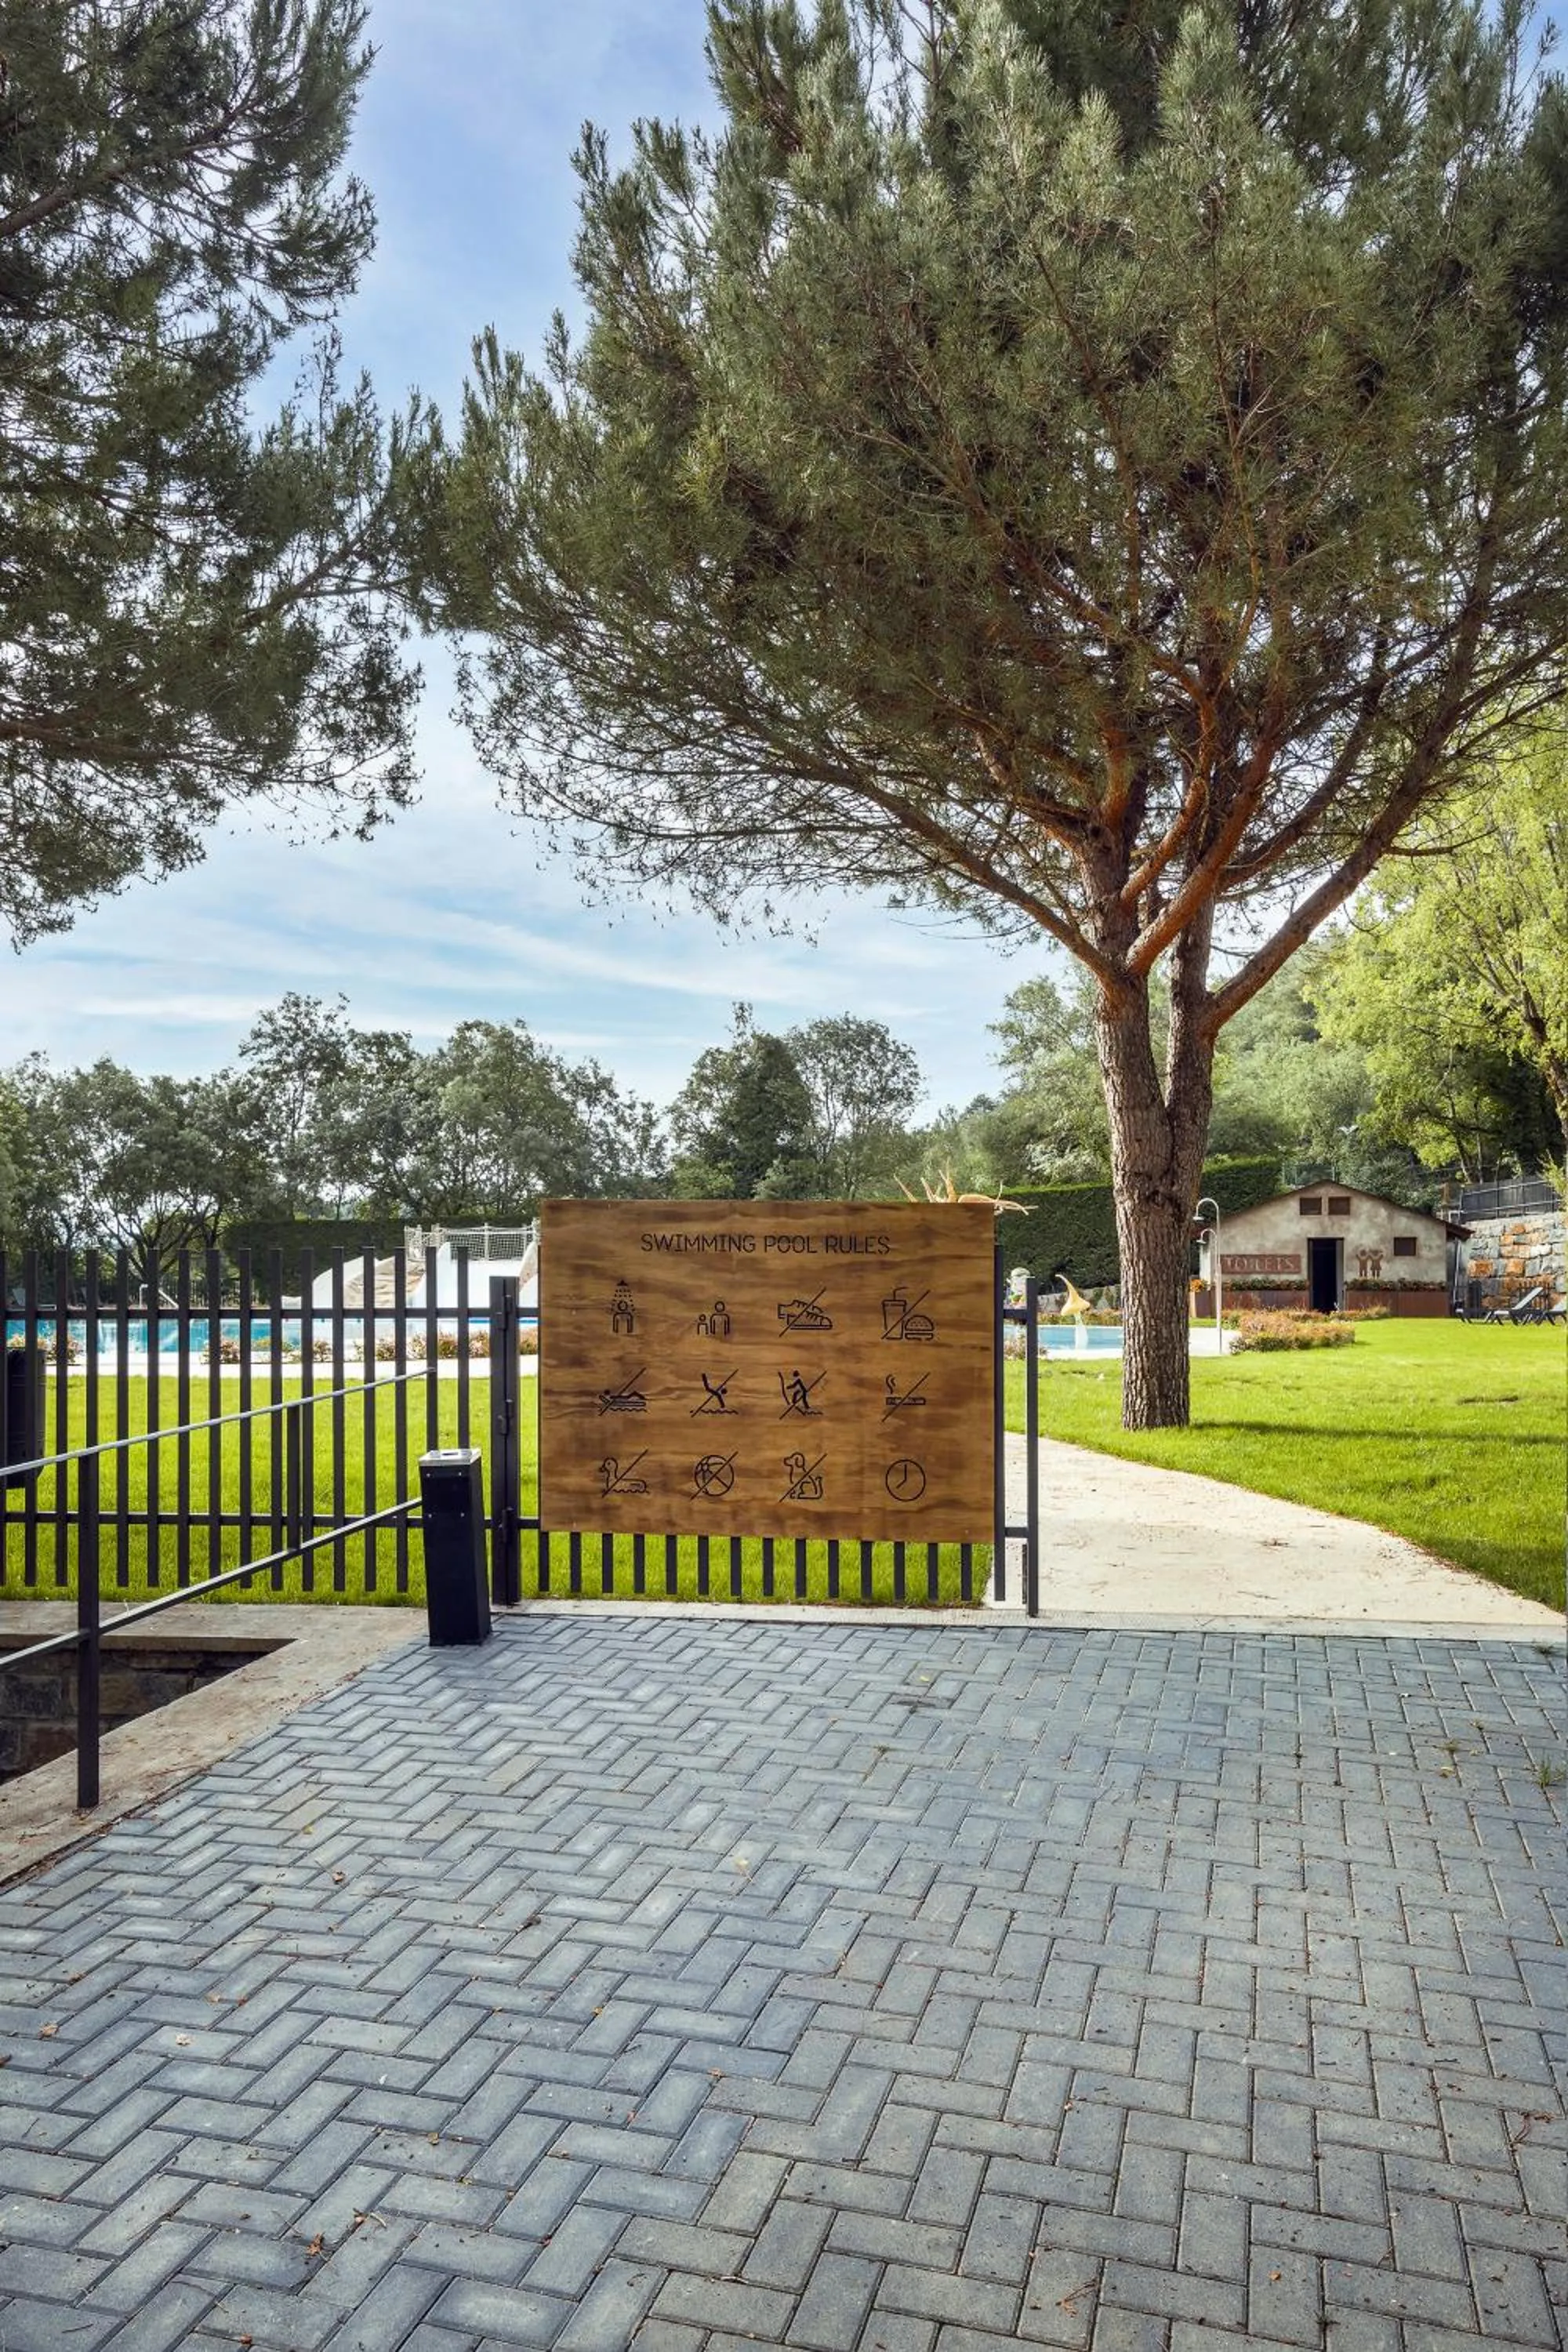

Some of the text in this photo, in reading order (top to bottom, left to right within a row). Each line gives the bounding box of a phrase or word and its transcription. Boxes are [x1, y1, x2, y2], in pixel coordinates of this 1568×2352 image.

[641, 1232, 891, 1255] SWIMMING POOL RULES
[1223, 1257, 1294, 1271] TOILETS
